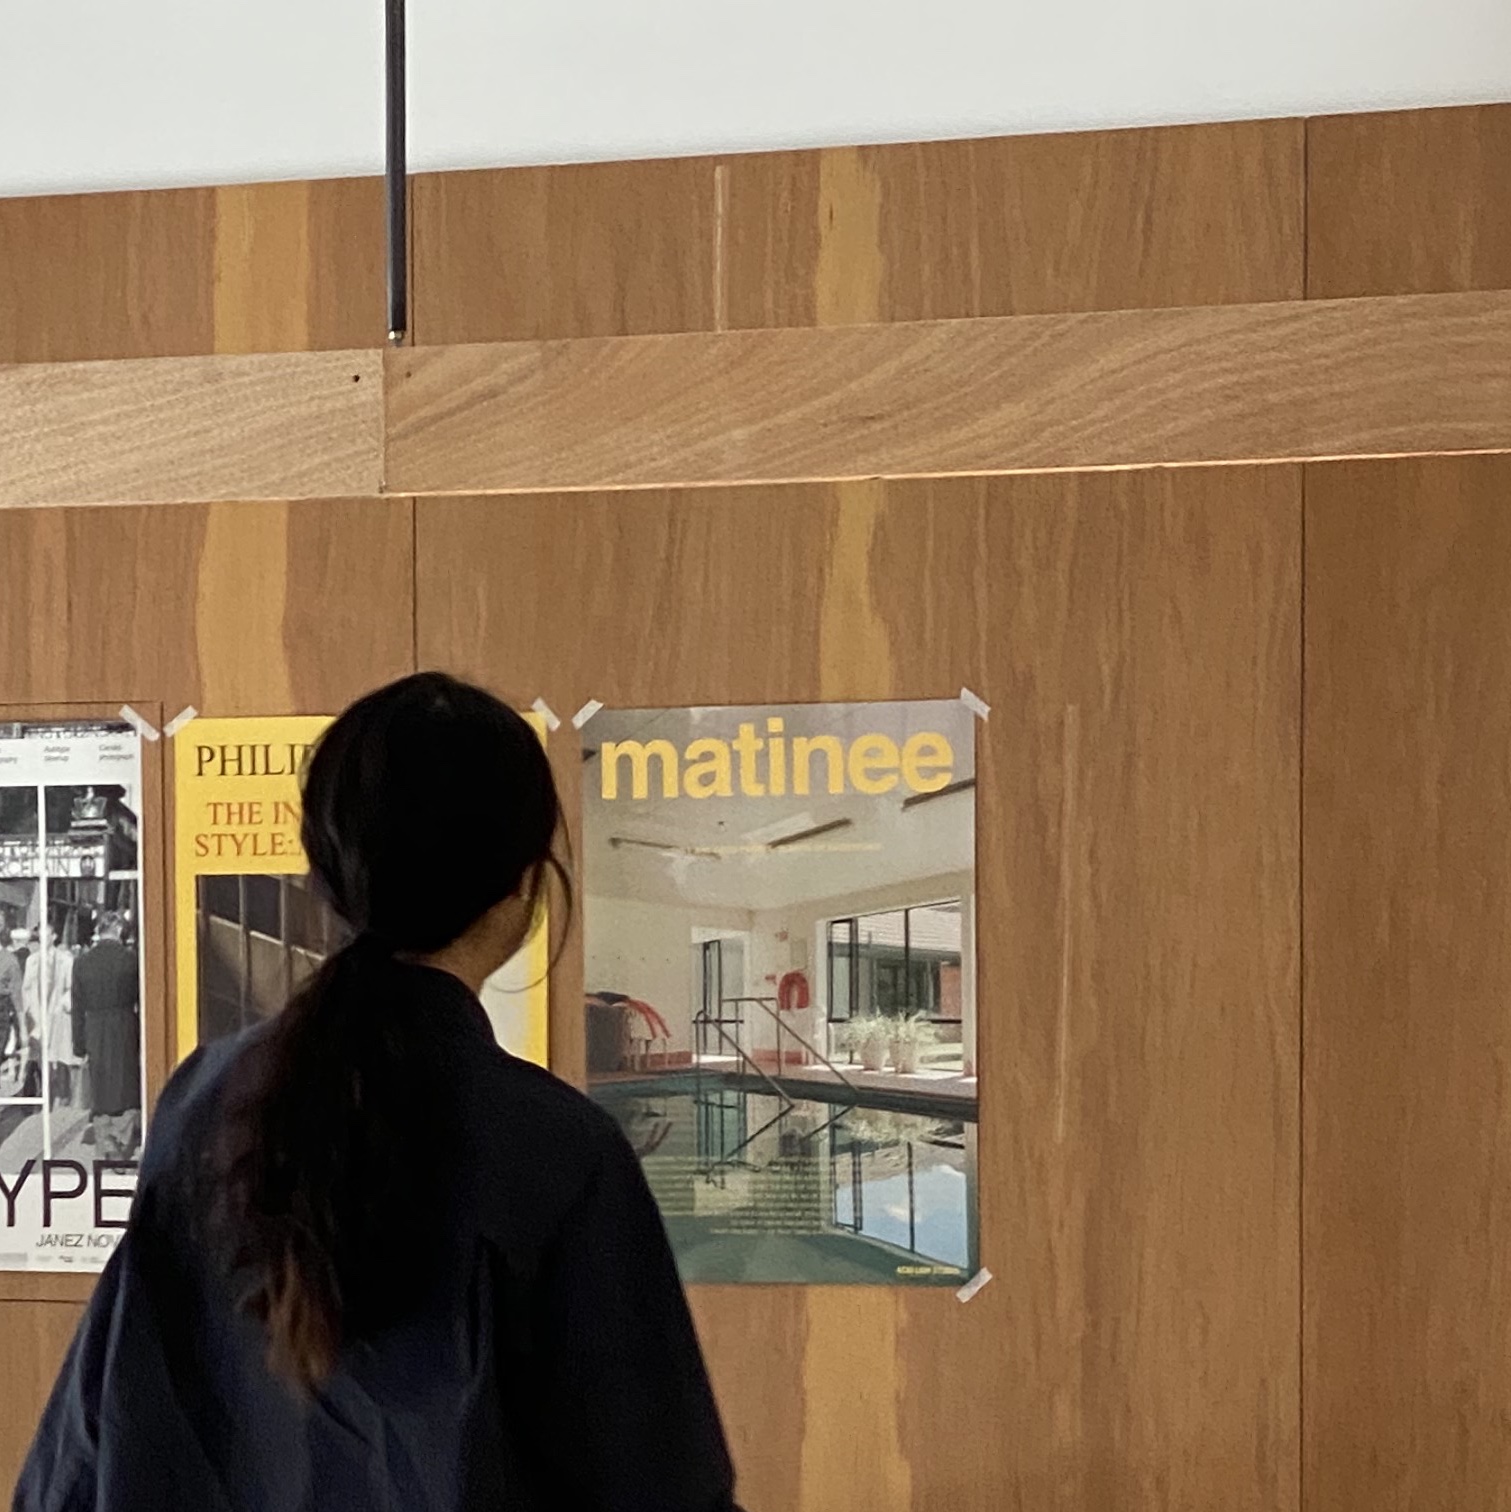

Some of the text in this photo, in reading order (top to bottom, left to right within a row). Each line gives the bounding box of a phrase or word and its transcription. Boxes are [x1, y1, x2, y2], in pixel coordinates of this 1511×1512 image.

[601, 716, 955, 801] matinee
[207, 802, 264, 825] THE
[35, 1233, 85, 1248] JANEZ
